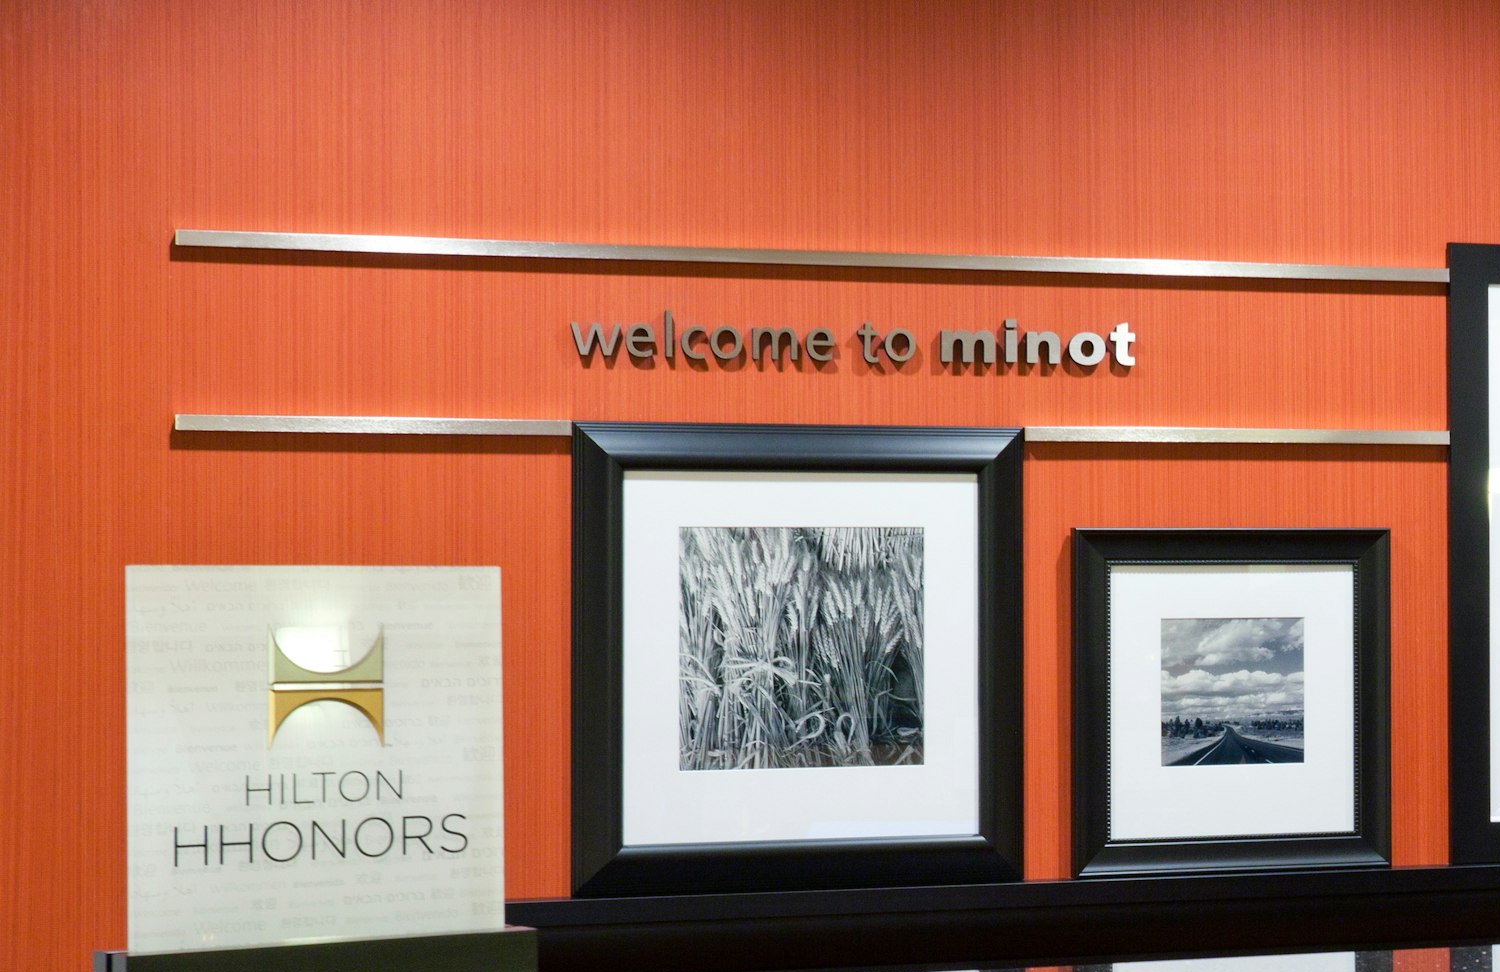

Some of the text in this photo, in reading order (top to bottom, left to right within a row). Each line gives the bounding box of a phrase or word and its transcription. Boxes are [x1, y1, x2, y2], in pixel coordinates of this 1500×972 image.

[569, 309, 1137, 368] welcome to minot
[245, 769, 403, 806] HILTON
[174, 813, 469, 868] HHONORS
